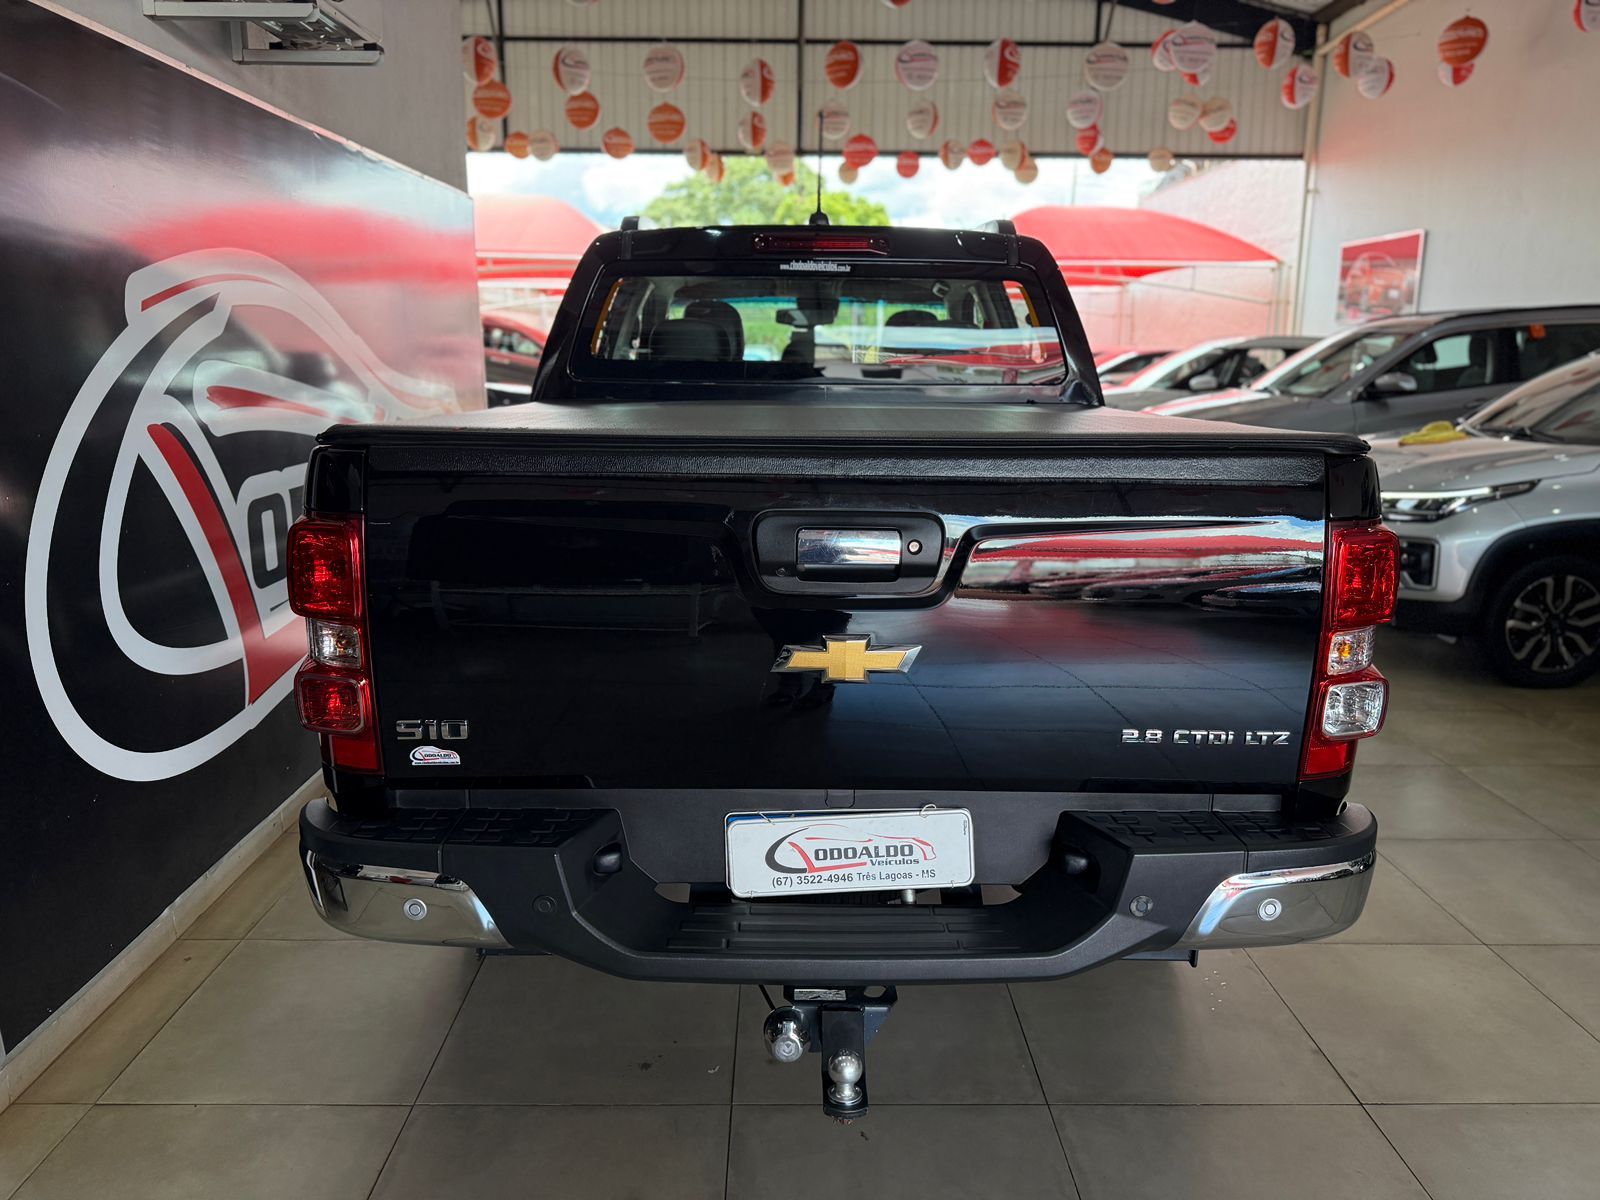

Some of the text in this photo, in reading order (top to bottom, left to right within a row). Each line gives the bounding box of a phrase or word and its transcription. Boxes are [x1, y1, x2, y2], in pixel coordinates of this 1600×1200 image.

[396, 720, 468, 740] S10
[1121, 729, 1163, 743] 2.8
[1244, 731, 1291, 745] LTZ
[870, 857, 920, 867] Veículos
[772, 876, 793, 888] (67)
[796, 873, 853, 886] 3522-4946
[856, 872, 877, 882] Três
[879, 871, 913, 882] Lagoas
[921, 869, 936, 879] MS
